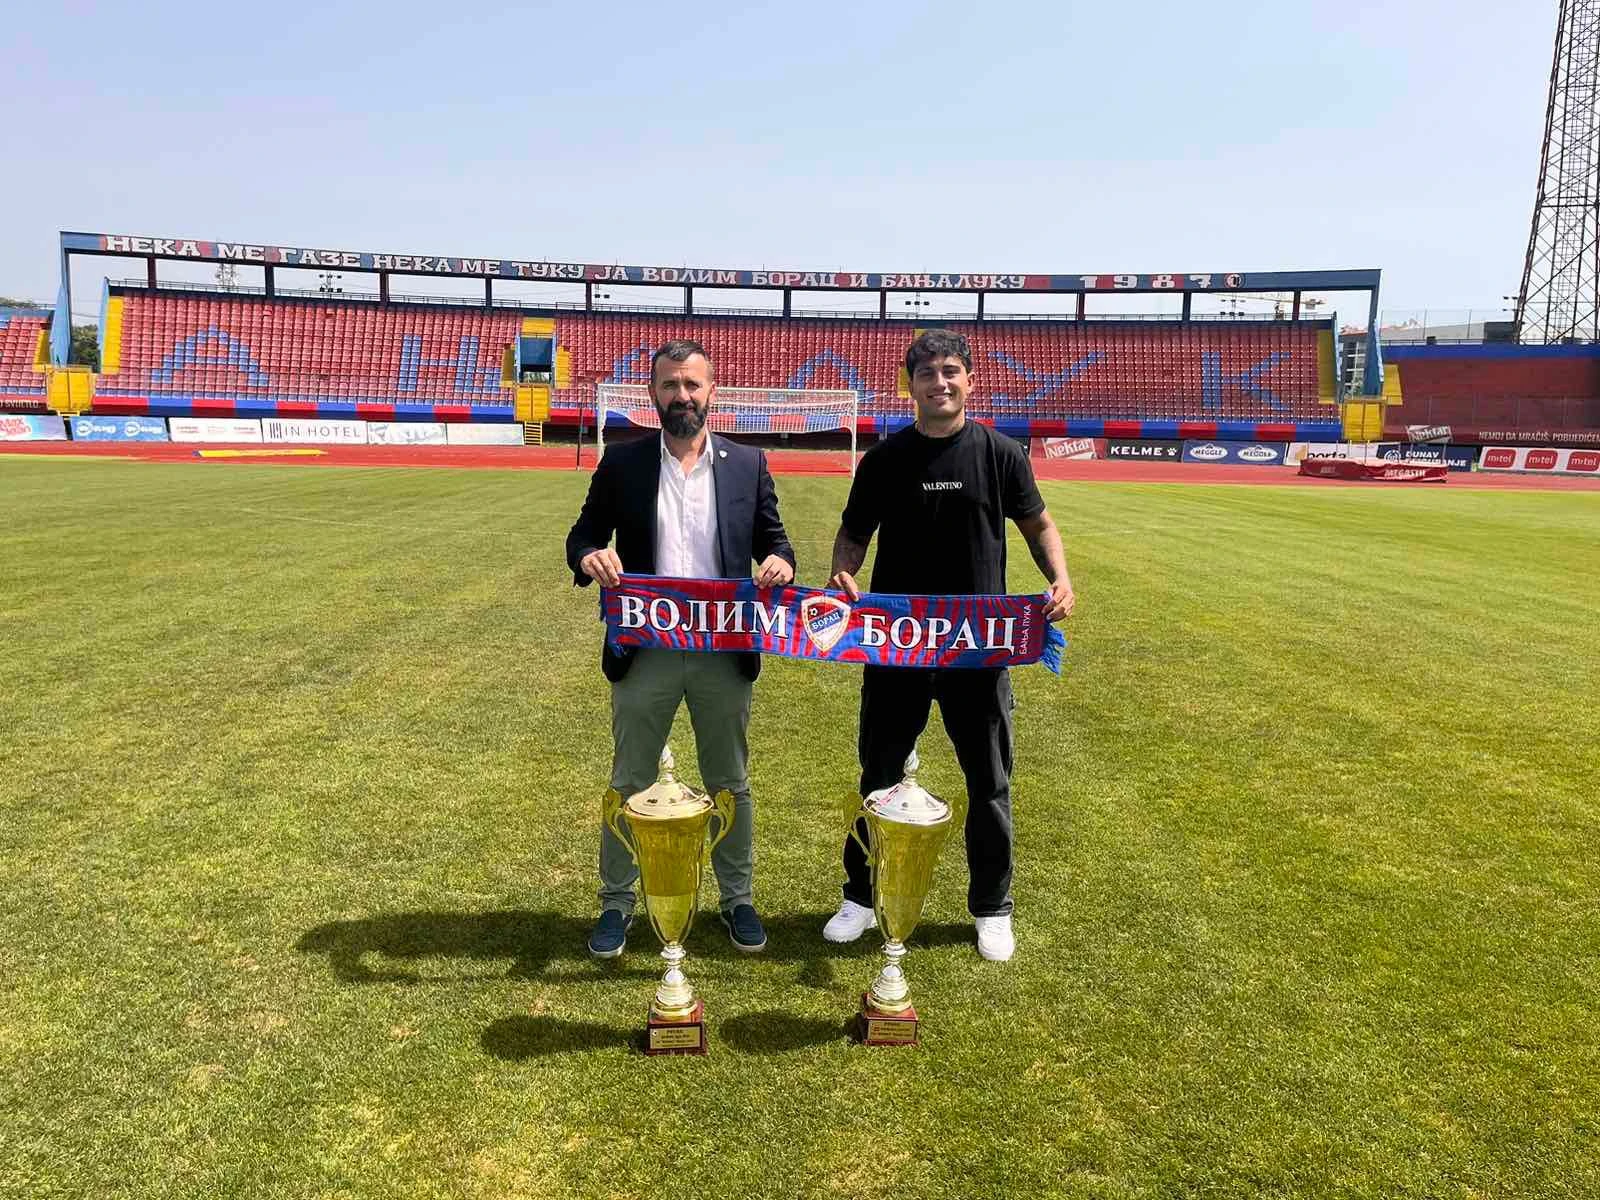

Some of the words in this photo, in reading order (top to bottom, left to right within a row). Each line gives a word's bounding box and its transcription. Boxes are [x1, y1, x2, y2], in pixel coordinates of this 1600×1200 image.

[105, 235, 201, 257] НЕКА
[217, 243, 265, 260] МЕ
[276, 248, 361, 267] ГАЗЕ
[372, 254, 452, 273] НЕКА
[460, 258, 501, 275] МЕ
[511, 260, 585, 279] ТУКУ
[641, 266, 738, 286] ВОЛИМ
[751, 271, 839, 288] БОРАЦ
[849, 272, 869, 288] И
[880, 274, 1027, 289] БАЊАЛУКУ
[285, 425, 300, 437] IN
[308, 425, 361, 438] HOTEL
[1506, 431, 1517, 441] DA
[1046, 439, 1092, 459] Nektar
[1110, 446, 1163, 456] KELME
[1405, 450, 1440, 458] DUNAV
[922, 481, 963, 491] VALENTINO
[617, 594, 789, 639] ВОЛИМ
[811, 611, 841, 630] БОРАЦ
[858, 613, 1018, 656] БОРАЦ
